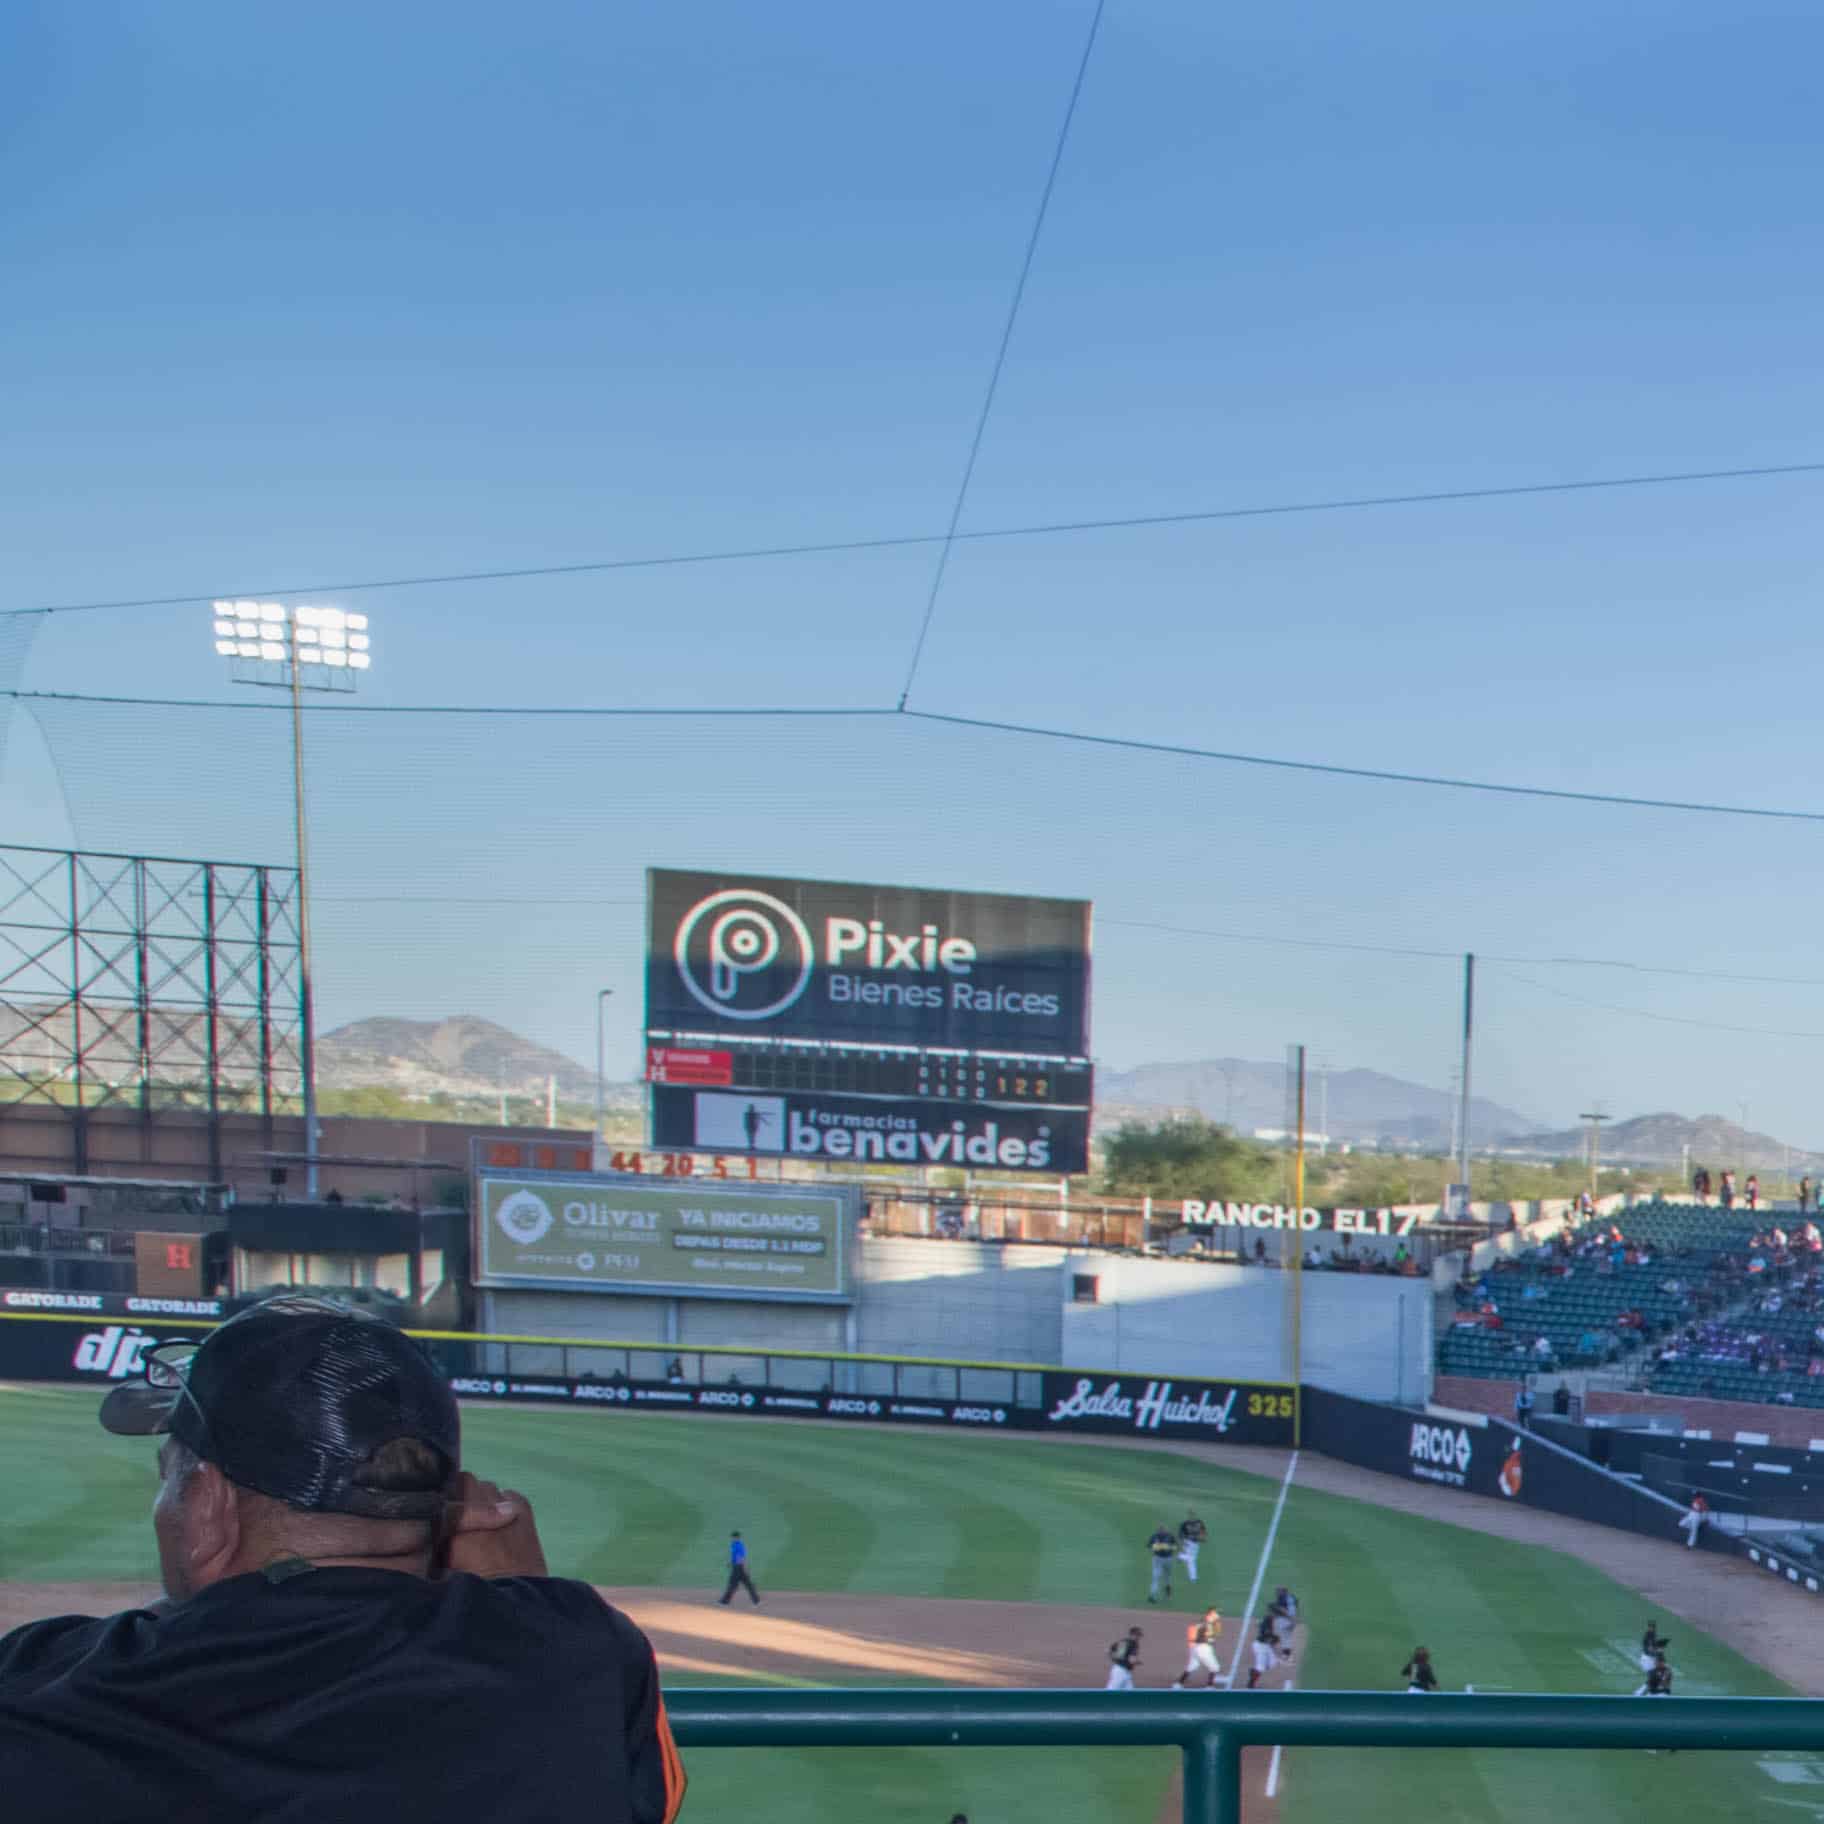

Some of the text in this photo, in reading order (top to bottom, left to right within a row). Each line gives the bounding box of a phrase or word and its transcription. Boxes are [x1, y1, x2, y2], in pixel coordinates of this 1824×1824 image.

[826, 917, 978, 974] Pixie
[828, 974, 1059, 1016] Bienes Raíces
[808, 1109, 918, 1130] farmacias
[790, 1110, 1050, 1167] benavides
[563, 1201, 661, 1230] Olivar
[678, 1207, 820, 1233] YA INICIAMOS
[1182, 1199, 1321, 1232] RANCHO
[166, 1244, 192, 1269] H
[6, 1291, 103, 1309] GATORADE
[126, 1297, 221, 1315] GATORADE
[451, 1378, 491, 1394] ARCO
[574, 1385, 616, 1400] ARCO
[699, 1392, 739, 1406] ARCO
[828, 1399, 867, 1415] ARCO
[1049, 1378, 1131, 1421] Salsa
[1248, 1393, 1294, 1418] 325
[952, 1407, 992, 1422] ARCO
[1409, 1423, 1456, 1465] ARCO
